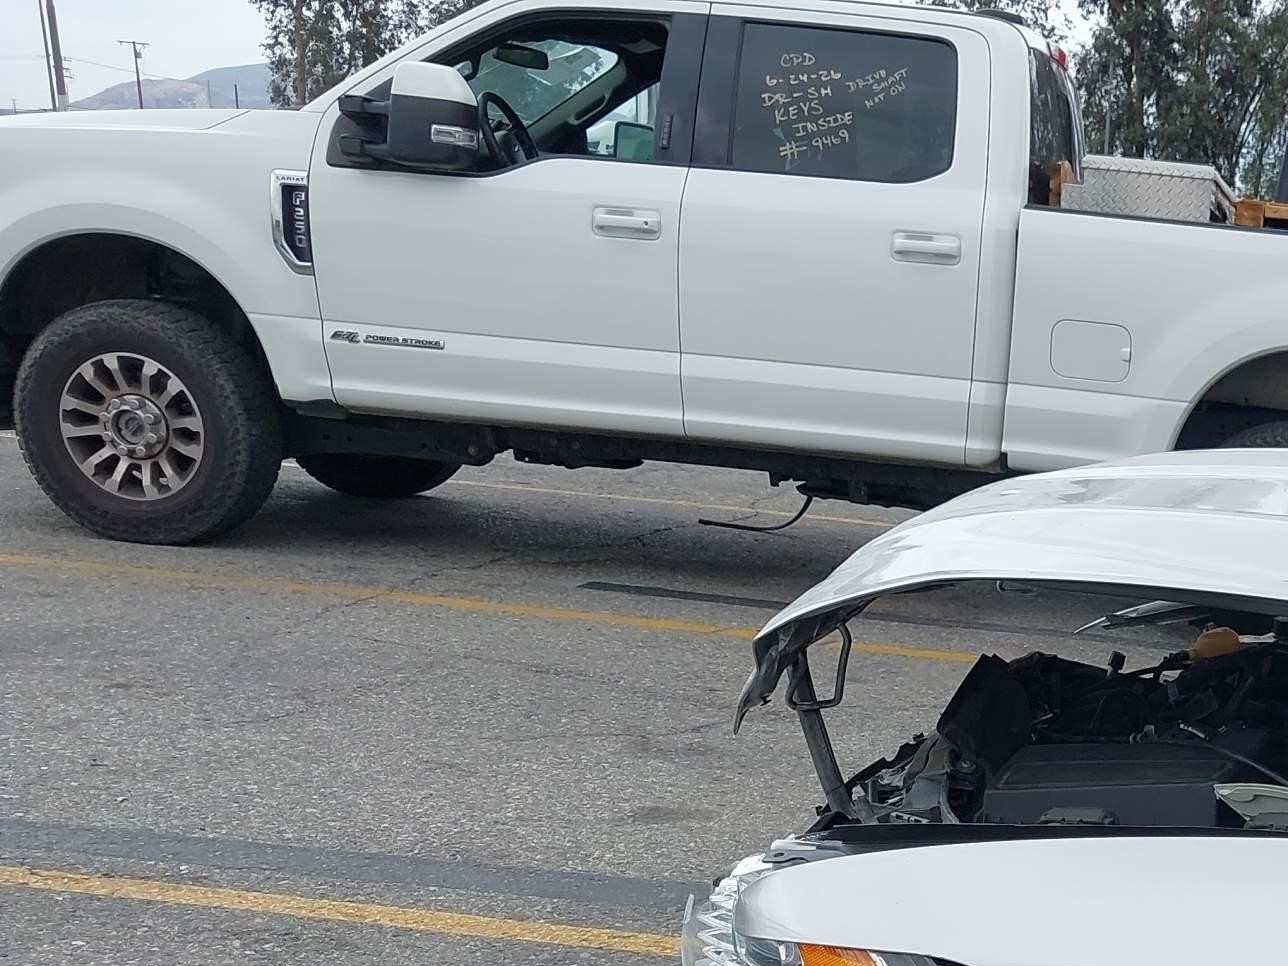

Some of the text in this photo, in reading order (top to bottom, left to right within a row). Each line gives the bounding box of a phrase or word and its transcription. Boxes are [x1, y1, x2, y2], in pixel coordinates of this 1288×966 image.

[780, 52, 816, 68] CPD
[871, 68, 909, 92] SHAFT
[864, 82, 906, 109] NOT ON
[774, 100, 824, 124] KEYS
[792, 112, 853, 137] INSIDE
[276, 175, 305, 183] LARIAT
[365, 334, 399, 343] POWER
[402, 337, 442, 347] STROKE
